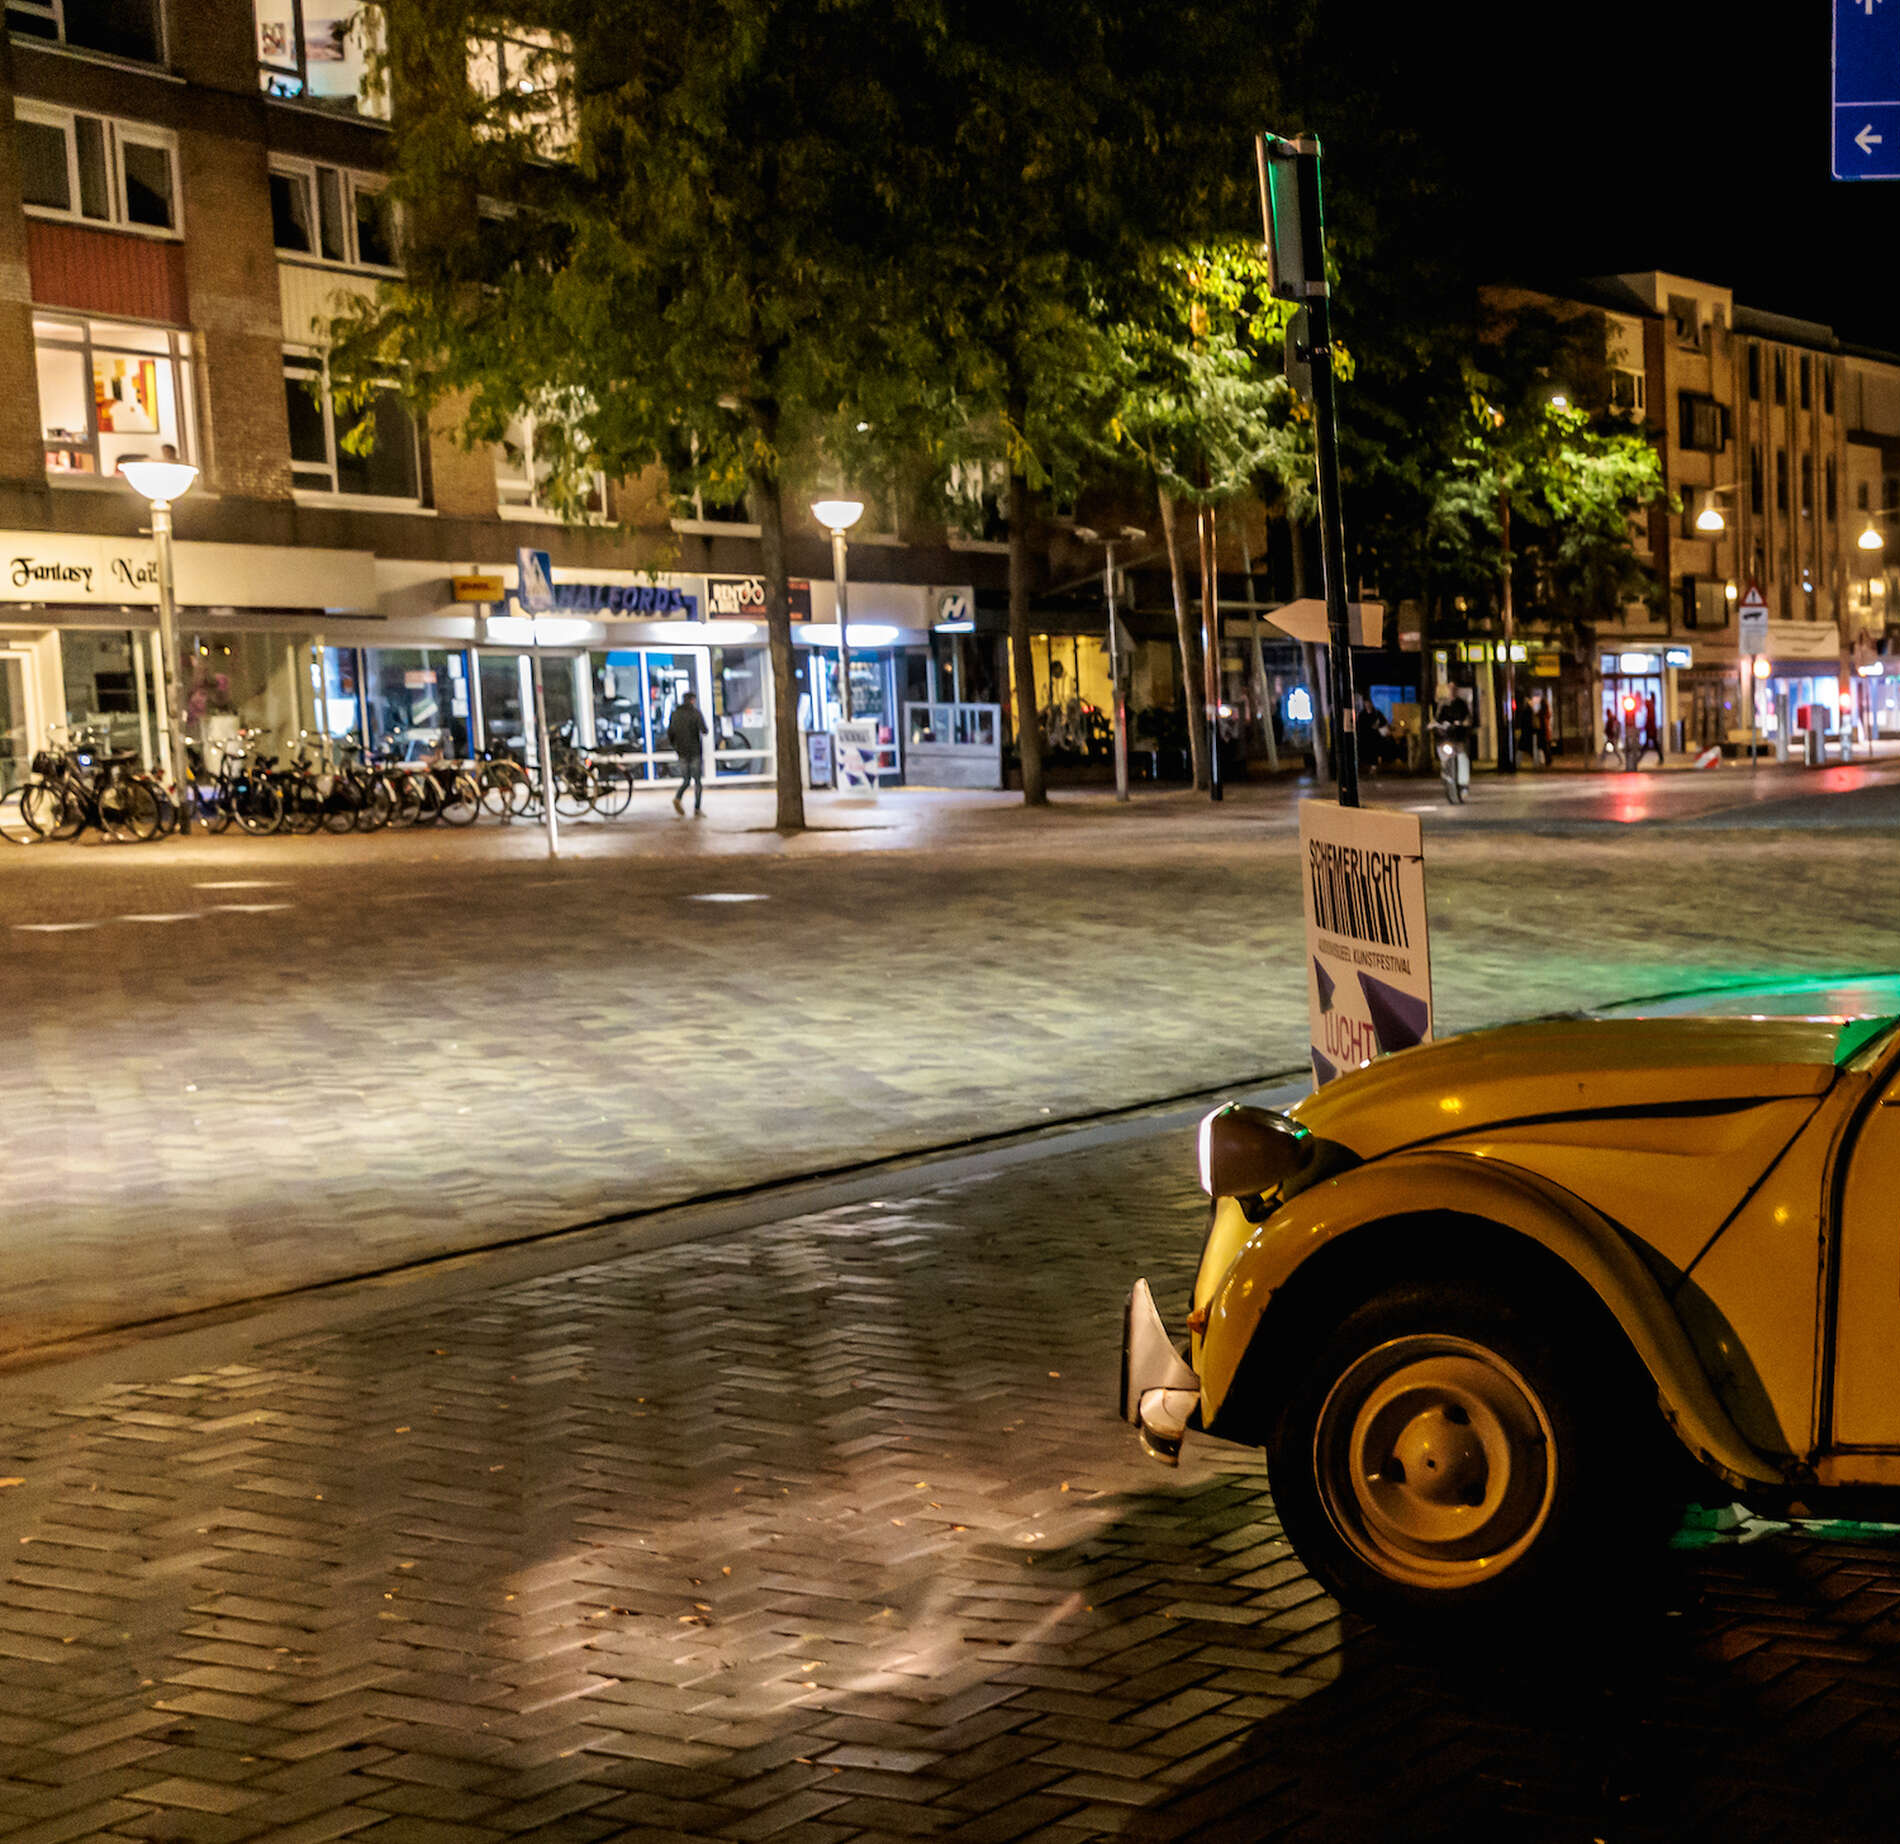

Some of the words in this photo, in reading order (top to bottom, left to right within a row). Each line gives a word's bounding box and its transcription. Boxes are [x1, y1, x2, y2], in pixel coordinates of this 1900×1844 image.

[11, 558, 94, 592] Fantasy
[556, 583, 684, 612] HALFORDS
[1353, 948, 1411, 976] KUNSTFESTIVAL
[1325, 1010, 1375, 1064] LUCHT
